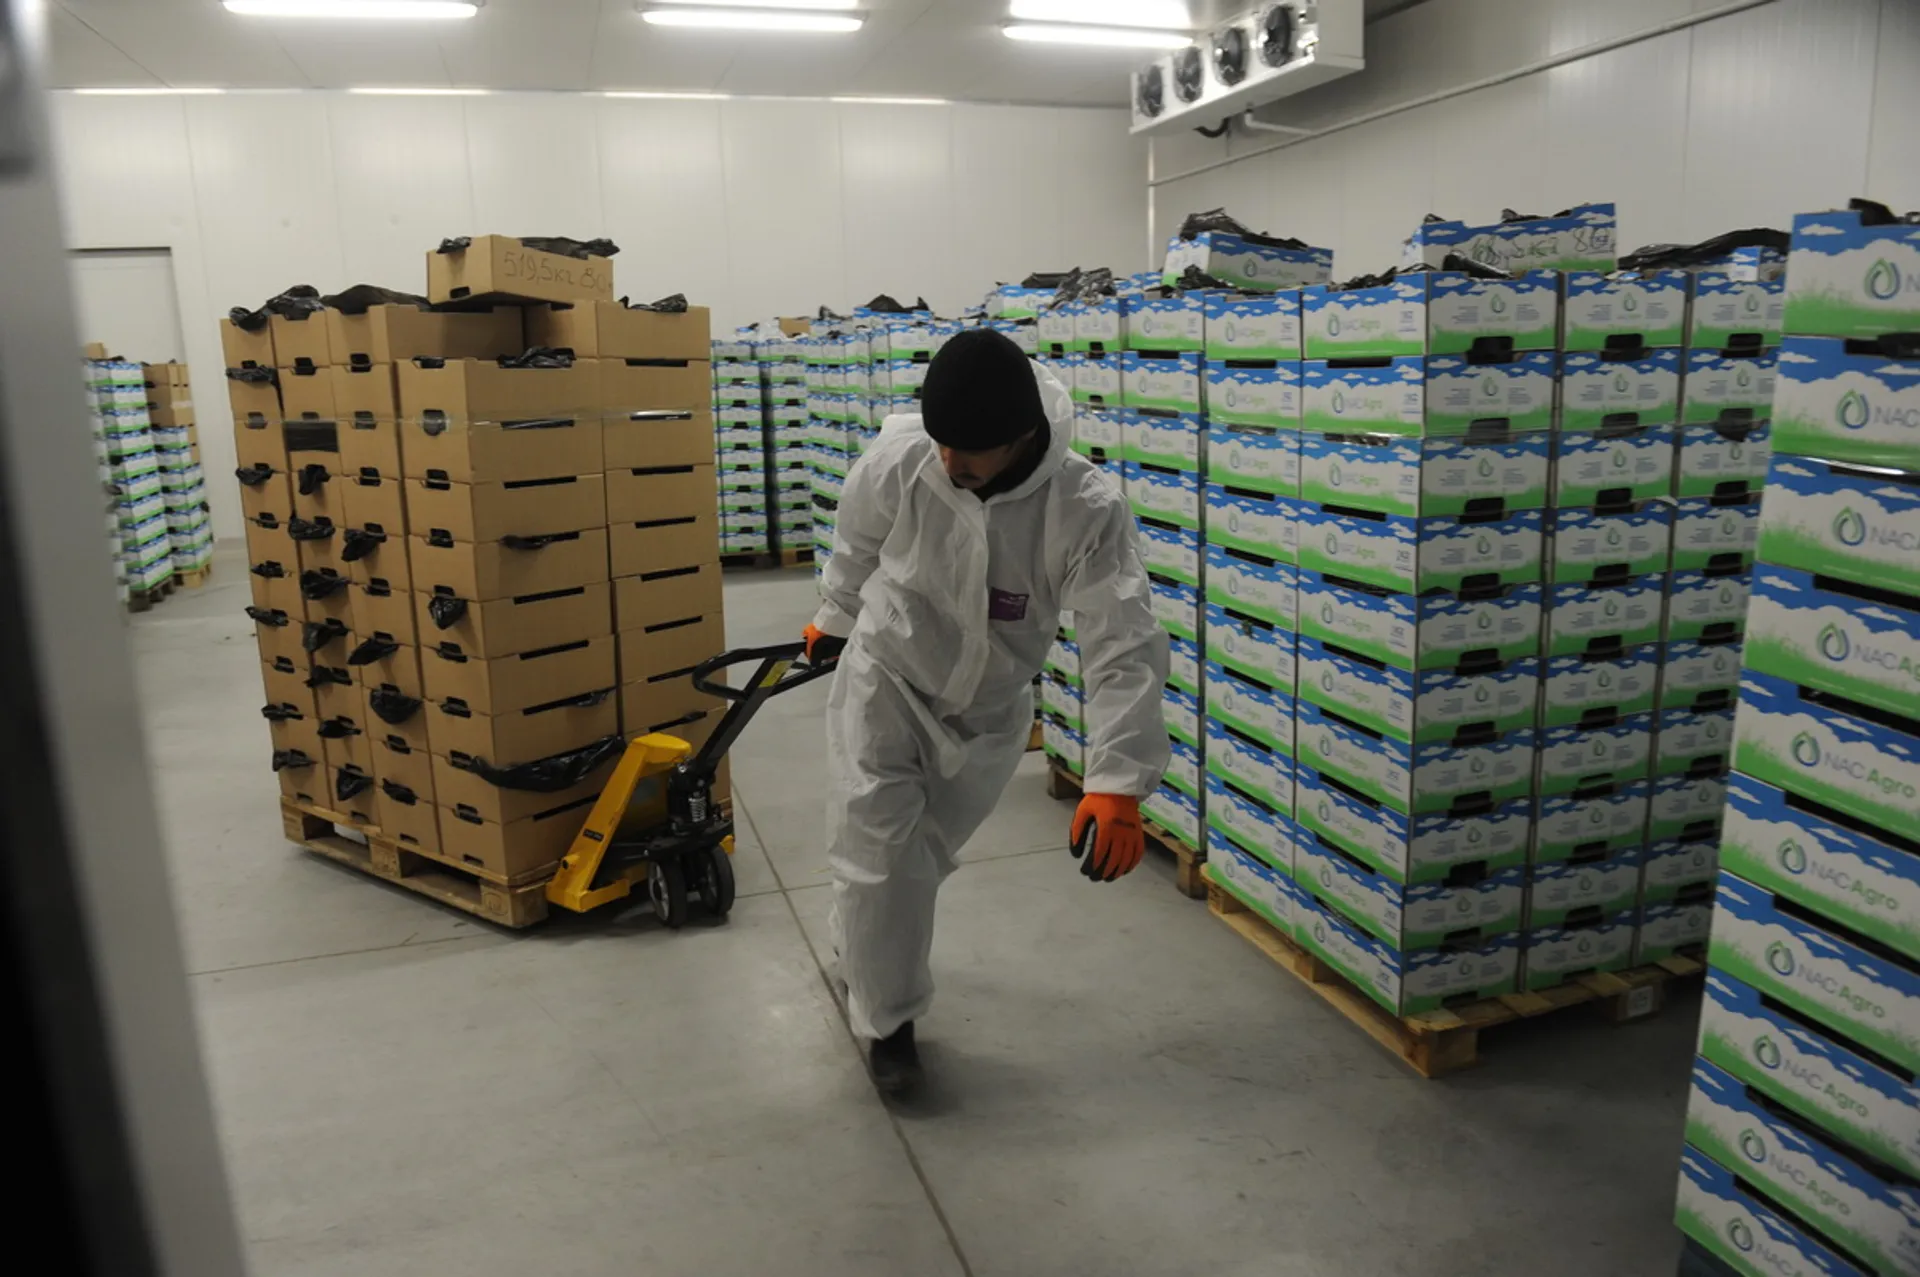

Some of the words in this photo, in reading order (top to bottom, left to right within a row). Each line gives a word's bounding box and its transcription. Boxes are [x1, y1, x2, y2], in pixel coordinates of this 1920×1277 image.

[1870, 524, 1920, 551] NAC
[1824, 752, 1917, 799] NACAgro
[1810, 861, 1898, 911] NACAgro
[1798, 963, 1885, 1018] NACAgro
[1784, 1058, 1869, 1118] NACAgro
